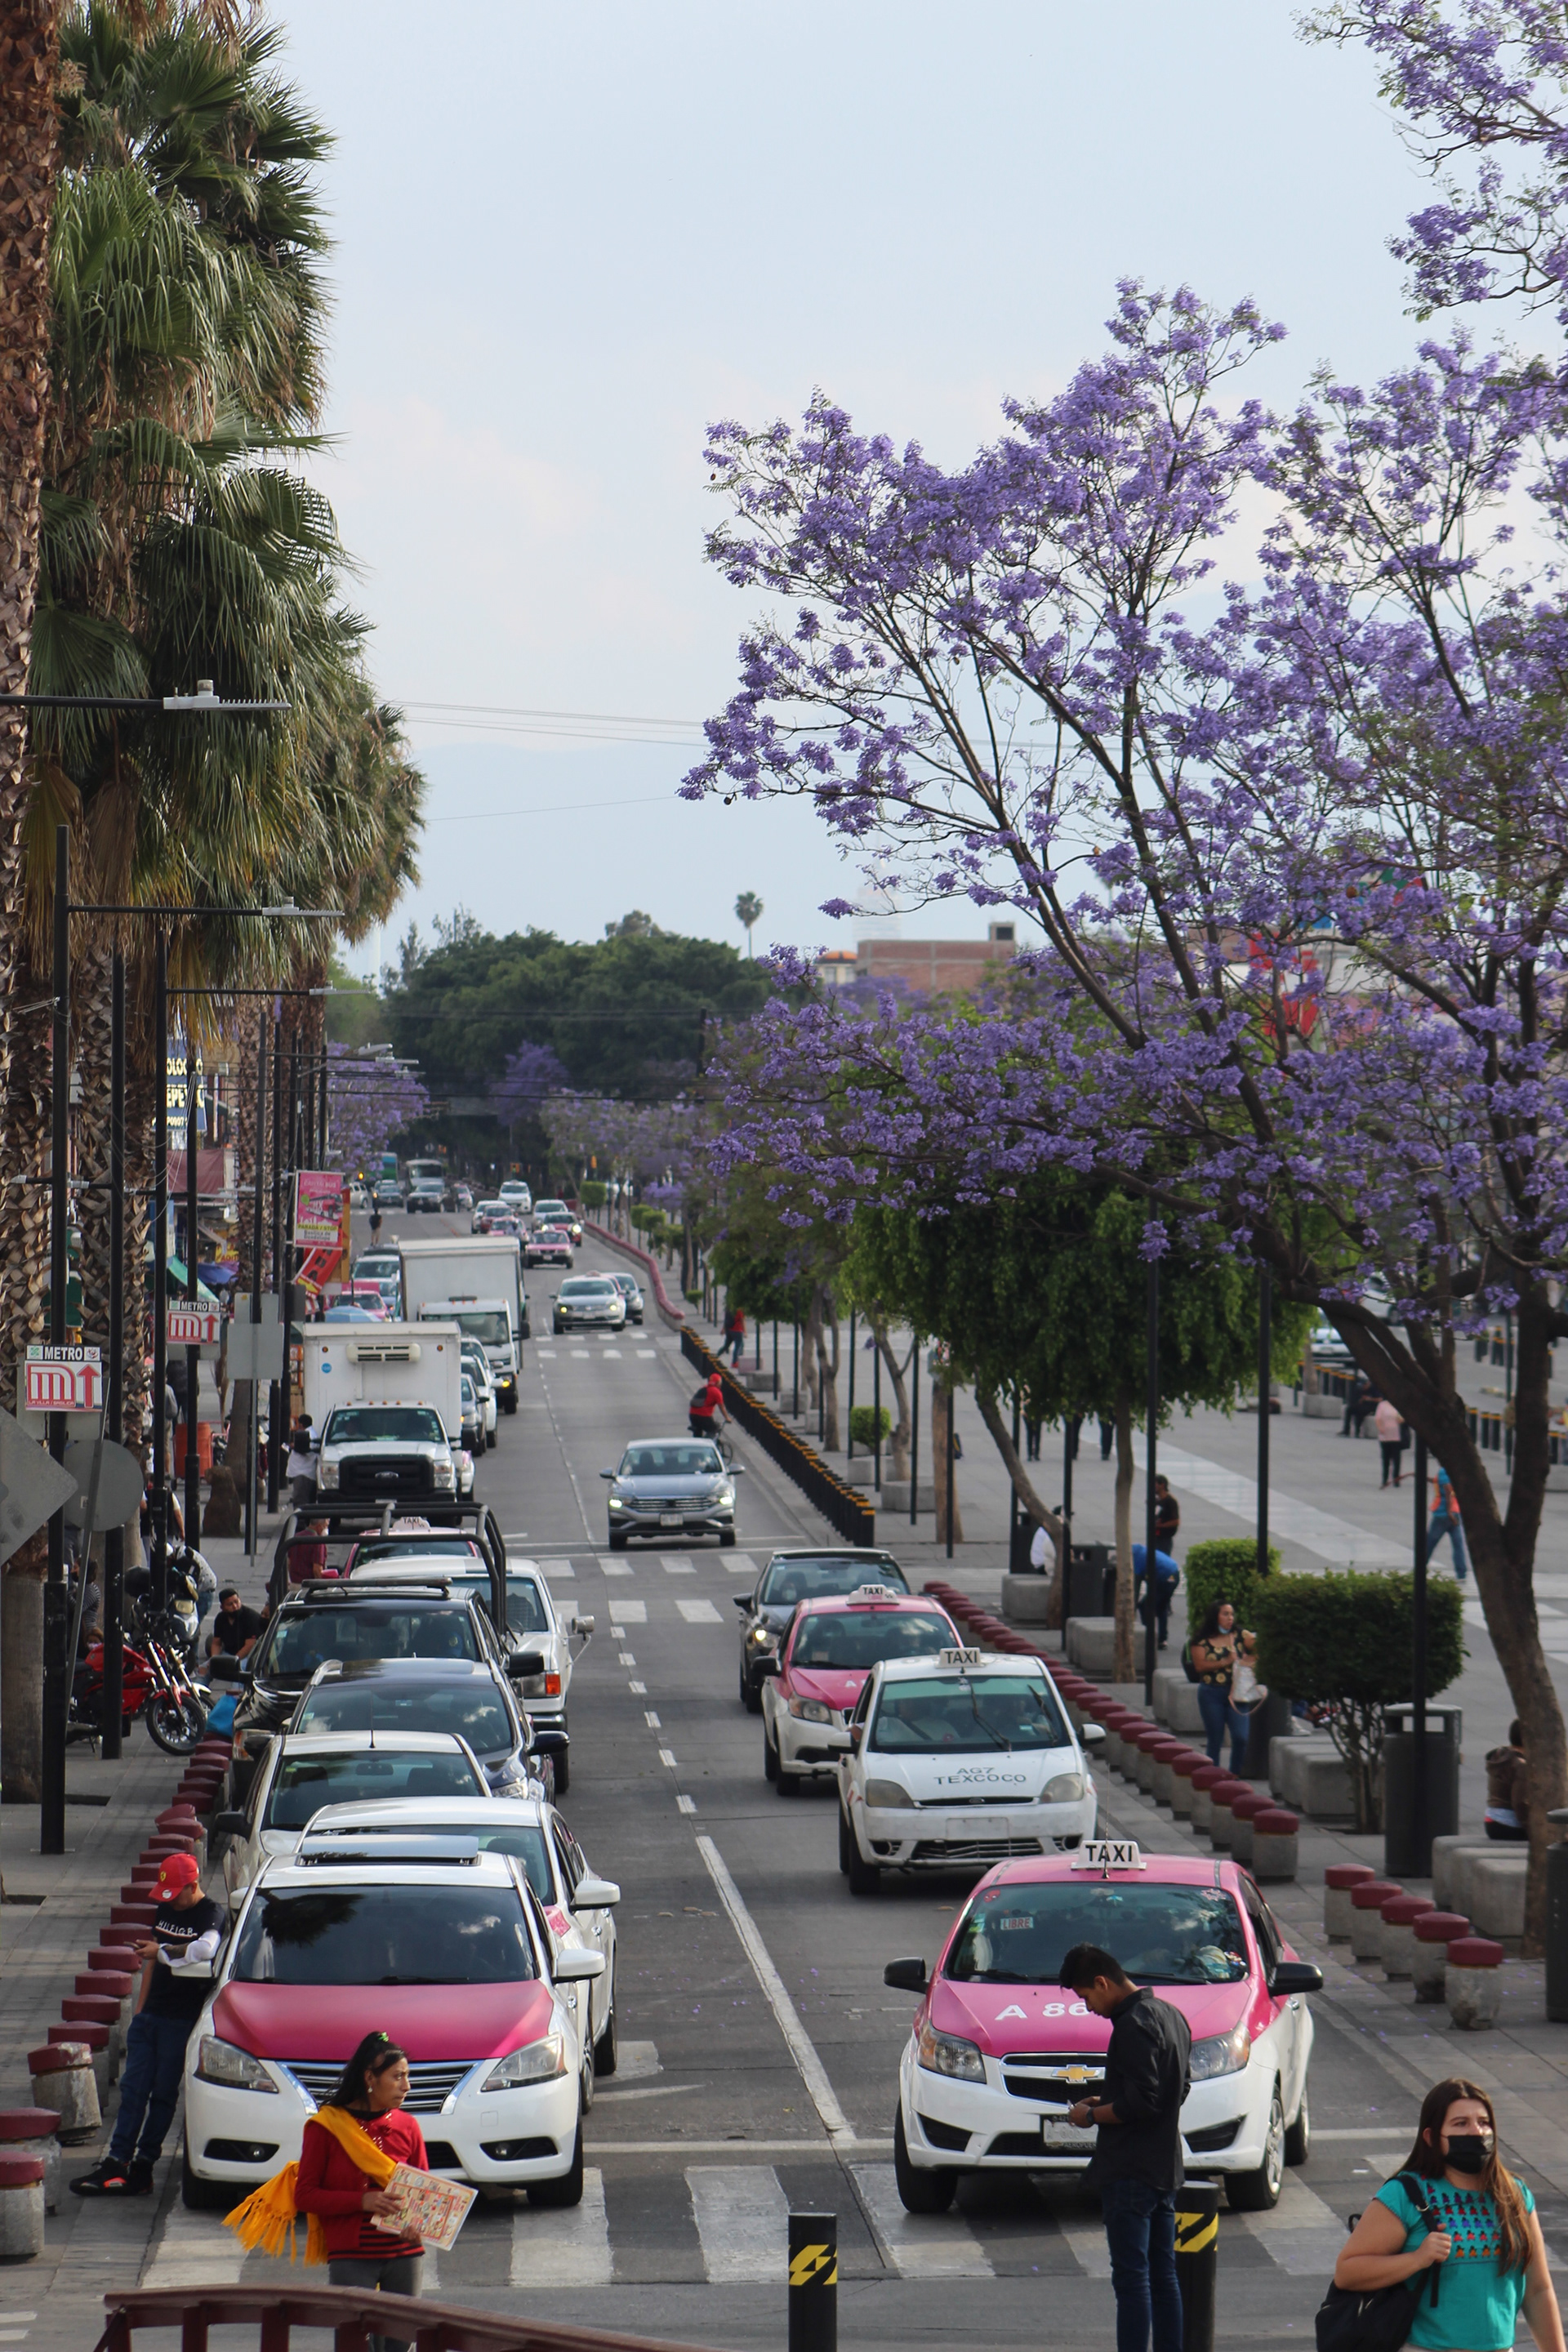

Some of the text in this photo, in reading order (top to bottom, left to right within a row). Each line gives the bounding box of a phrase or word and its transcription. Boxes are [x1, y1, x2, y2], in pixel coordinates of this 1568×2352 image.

[180, 1301, 208, 1312] METRO
[44, 1346, 82, 1361] METRO
[862, 1587, 884, 1595] TAXI
[945, 1650, 978, 1664] TAXI
[956, 1766, 995, 1775] AG7
[933, 1774, 1027, 1785] TEXCOCO
[1085, 1844, 1133, 1862] TAXI
[1002, 1918, 1030, 1930] LIBRE
[994, 2004, 1028, 2020] A
